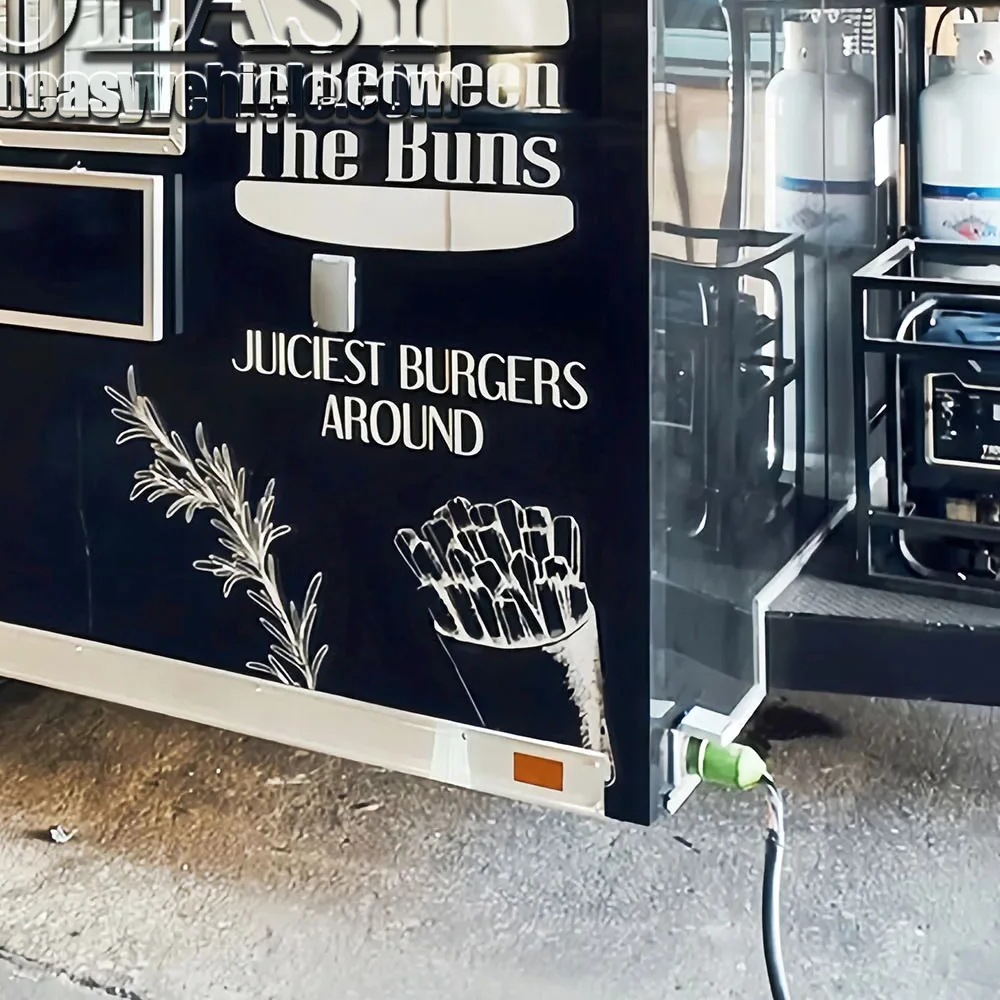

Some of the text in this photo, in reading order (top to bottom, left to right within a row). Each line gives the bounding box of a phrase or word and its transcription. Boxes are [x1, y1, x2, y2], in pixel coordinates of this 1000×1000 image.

[309, 52, 560, 109] Between
[235, 113, 562, 189] The Buns
[231, 328, 589, 411] JUICIEST BURGERS
[320, 393, 484, 457] AROUND
